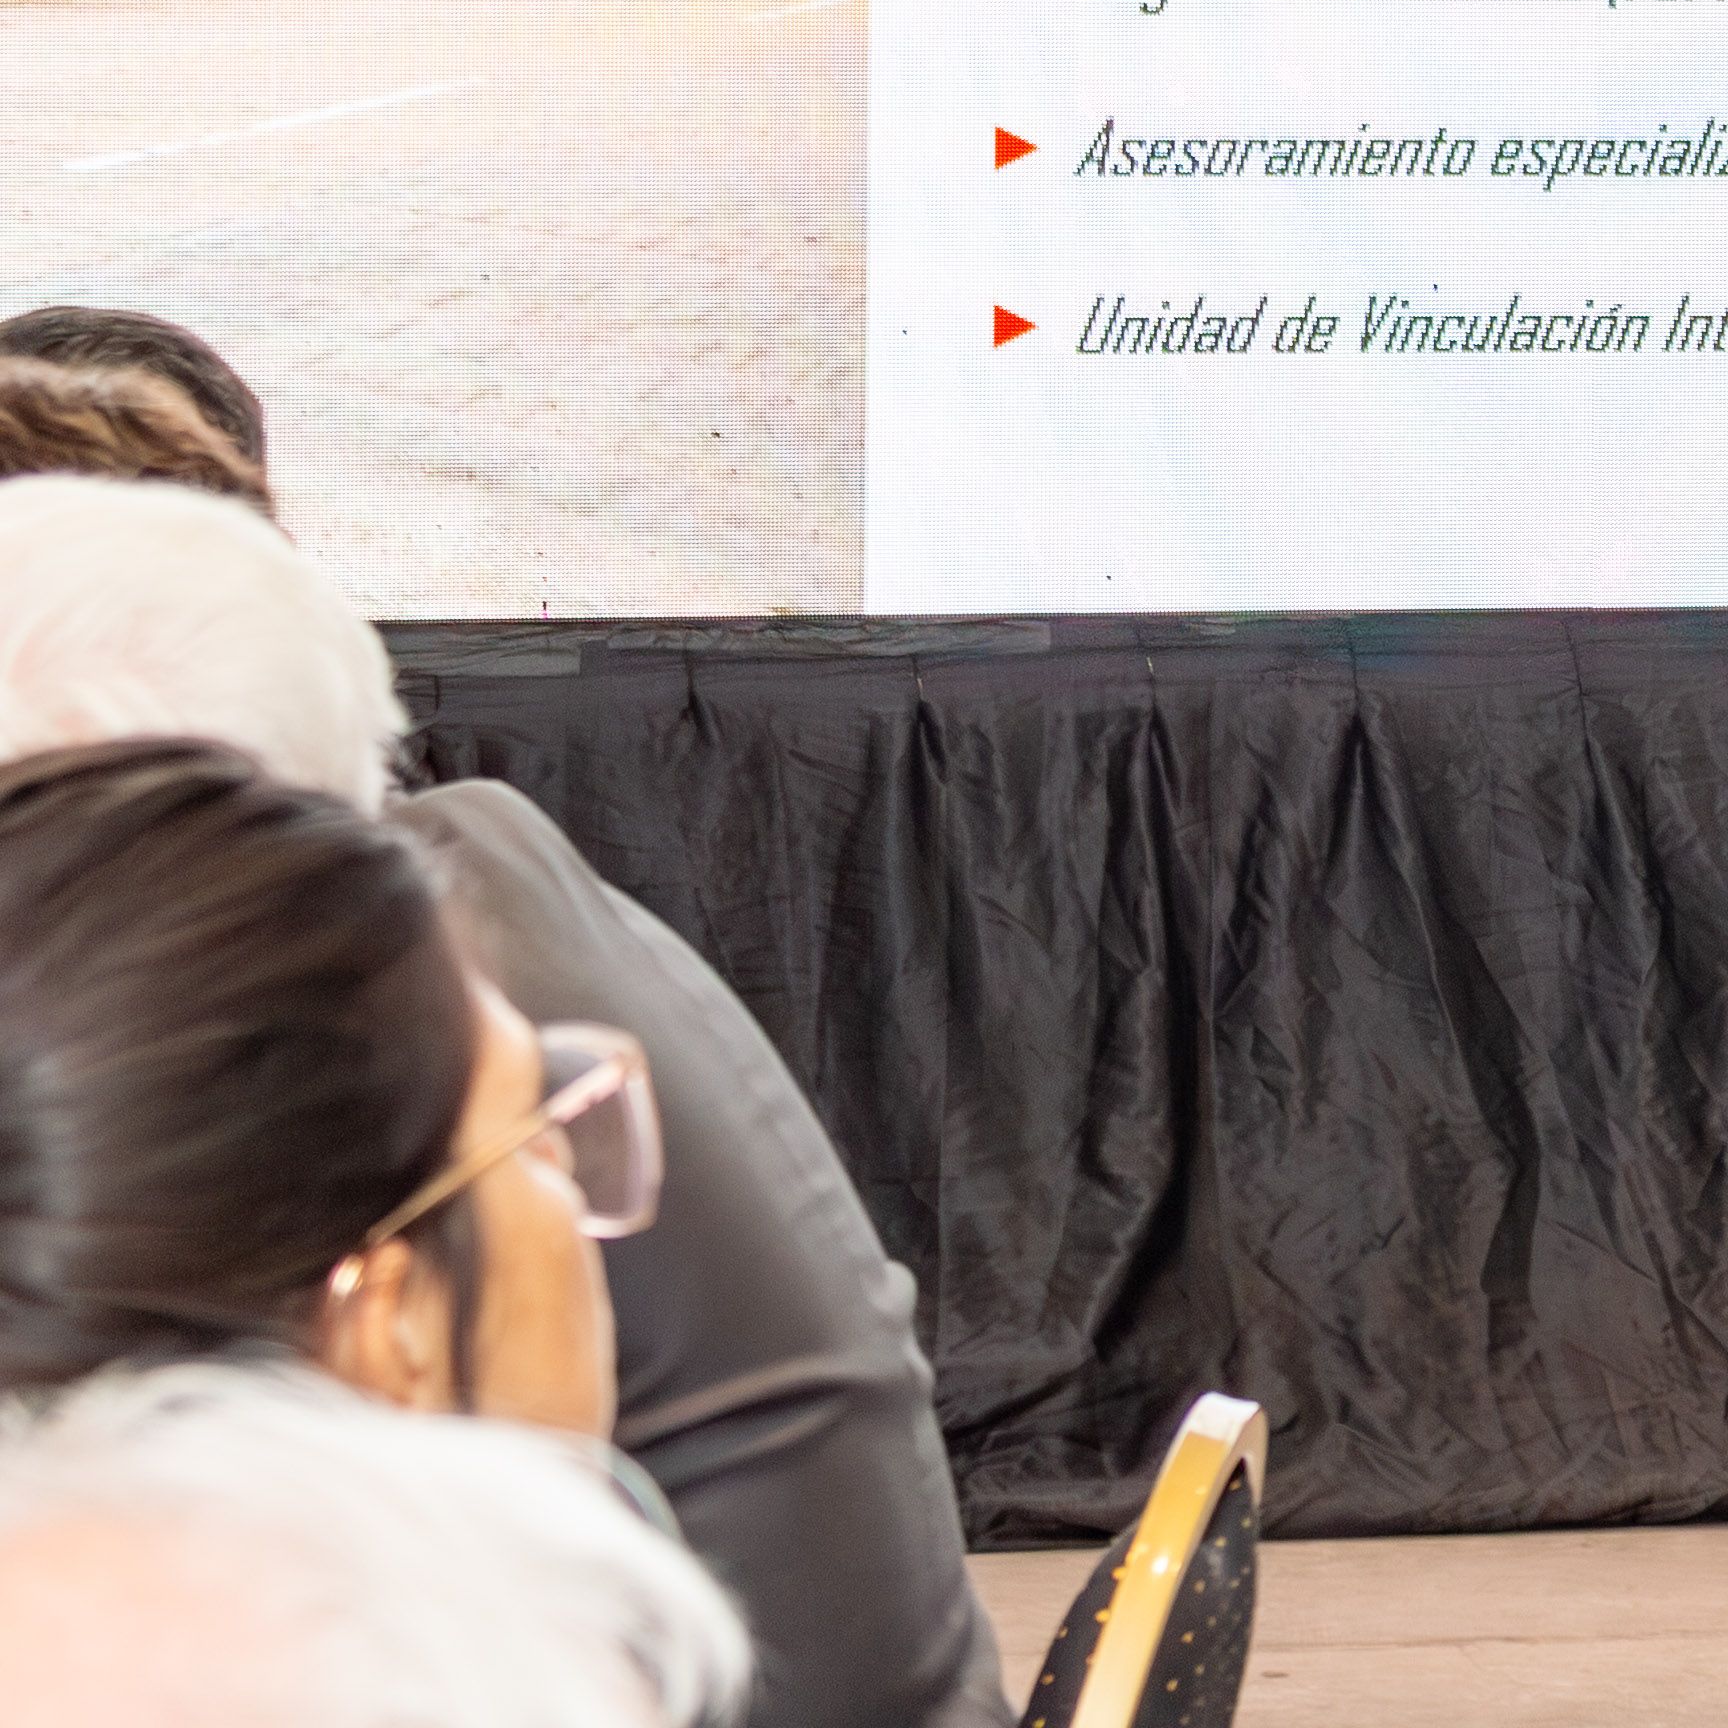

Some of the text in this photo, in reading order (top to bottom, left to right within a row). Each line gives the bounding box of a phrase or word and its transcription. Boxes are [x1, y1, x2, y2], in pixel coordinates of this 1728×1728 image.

[1077, 120, 1475, 175] Asesoramiento
[1078, 298, 1266, 352] Unidad
[1274, 297, 1338, 351] de
[1362, 296, 1649, 351] Vinculación
